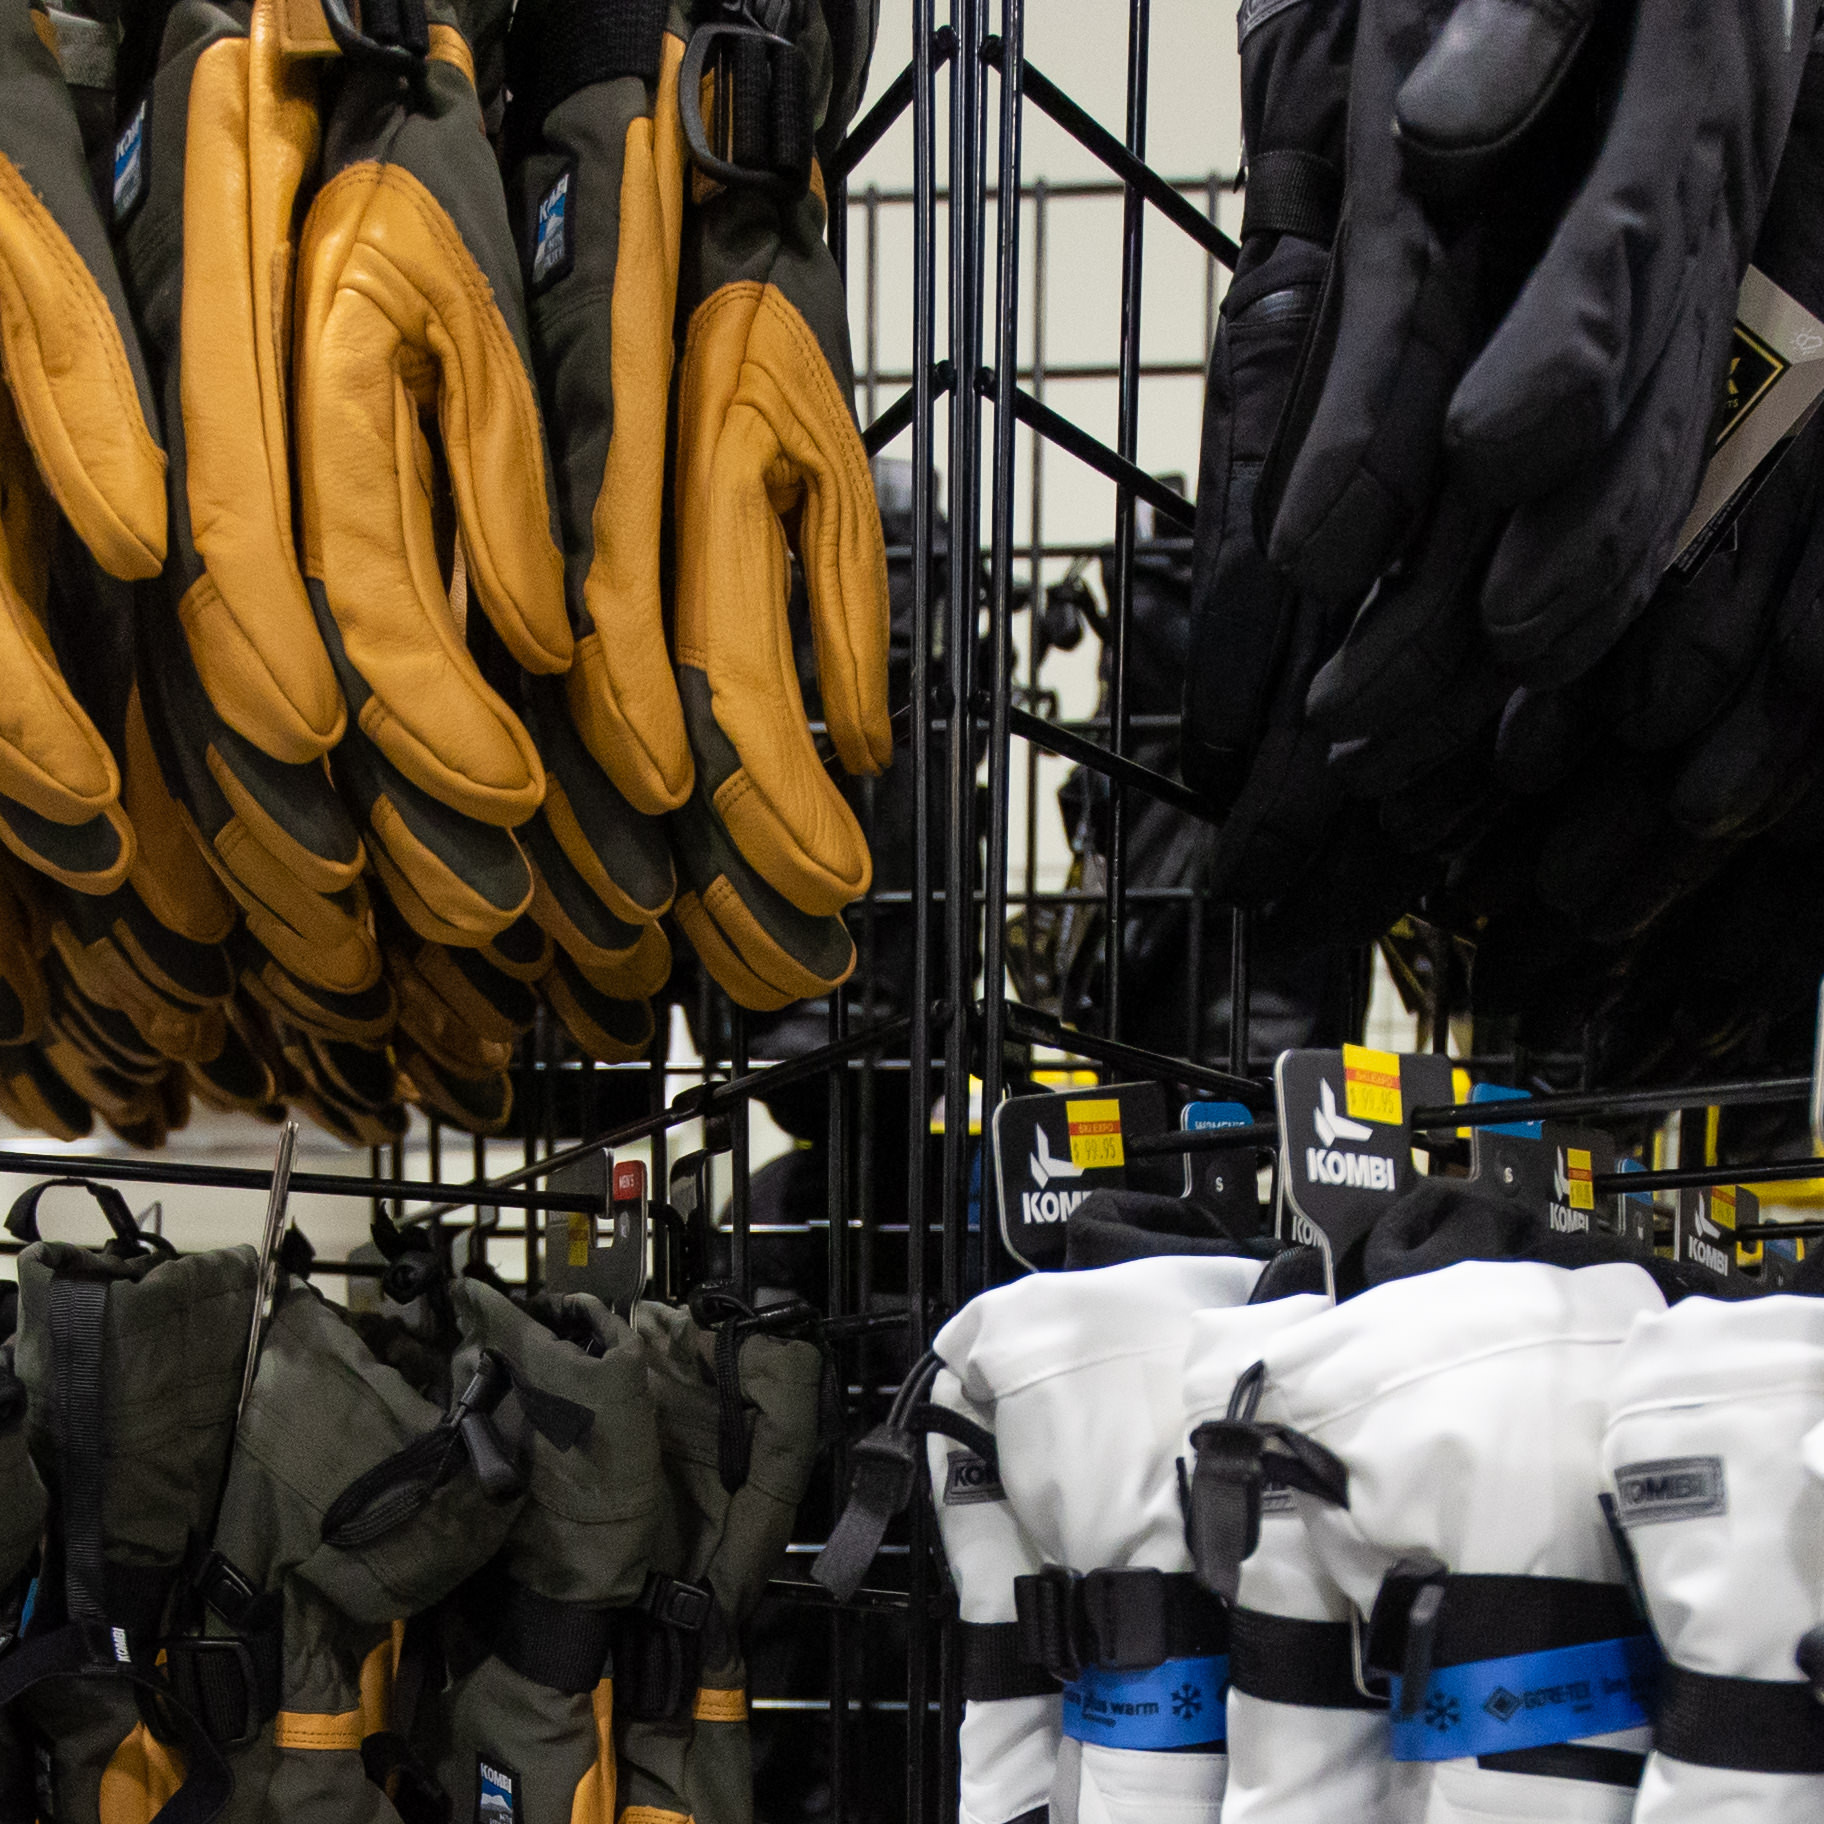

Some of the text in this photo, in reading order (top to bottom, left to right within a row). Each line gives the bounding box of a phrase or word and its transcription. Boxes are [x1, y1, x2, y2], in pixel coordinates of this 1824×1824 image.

[1084, 1137, 1117, 1162] 99.95
[1215, 1176, 1225, 1192] S
[1307, 1147, 1395, 1192] KOMBI
[1504, 1167, 1514, 1184] S
[1021, 1190, 1094, 1225] KOM
[1549, 1202, 1589, 1234] KOMBI
[1687, 1234, 1729, 1278] KOMBI
[111, 1625, 133, 1663] KOMBI
[479, 1762, 513, 1794] KOMBI
